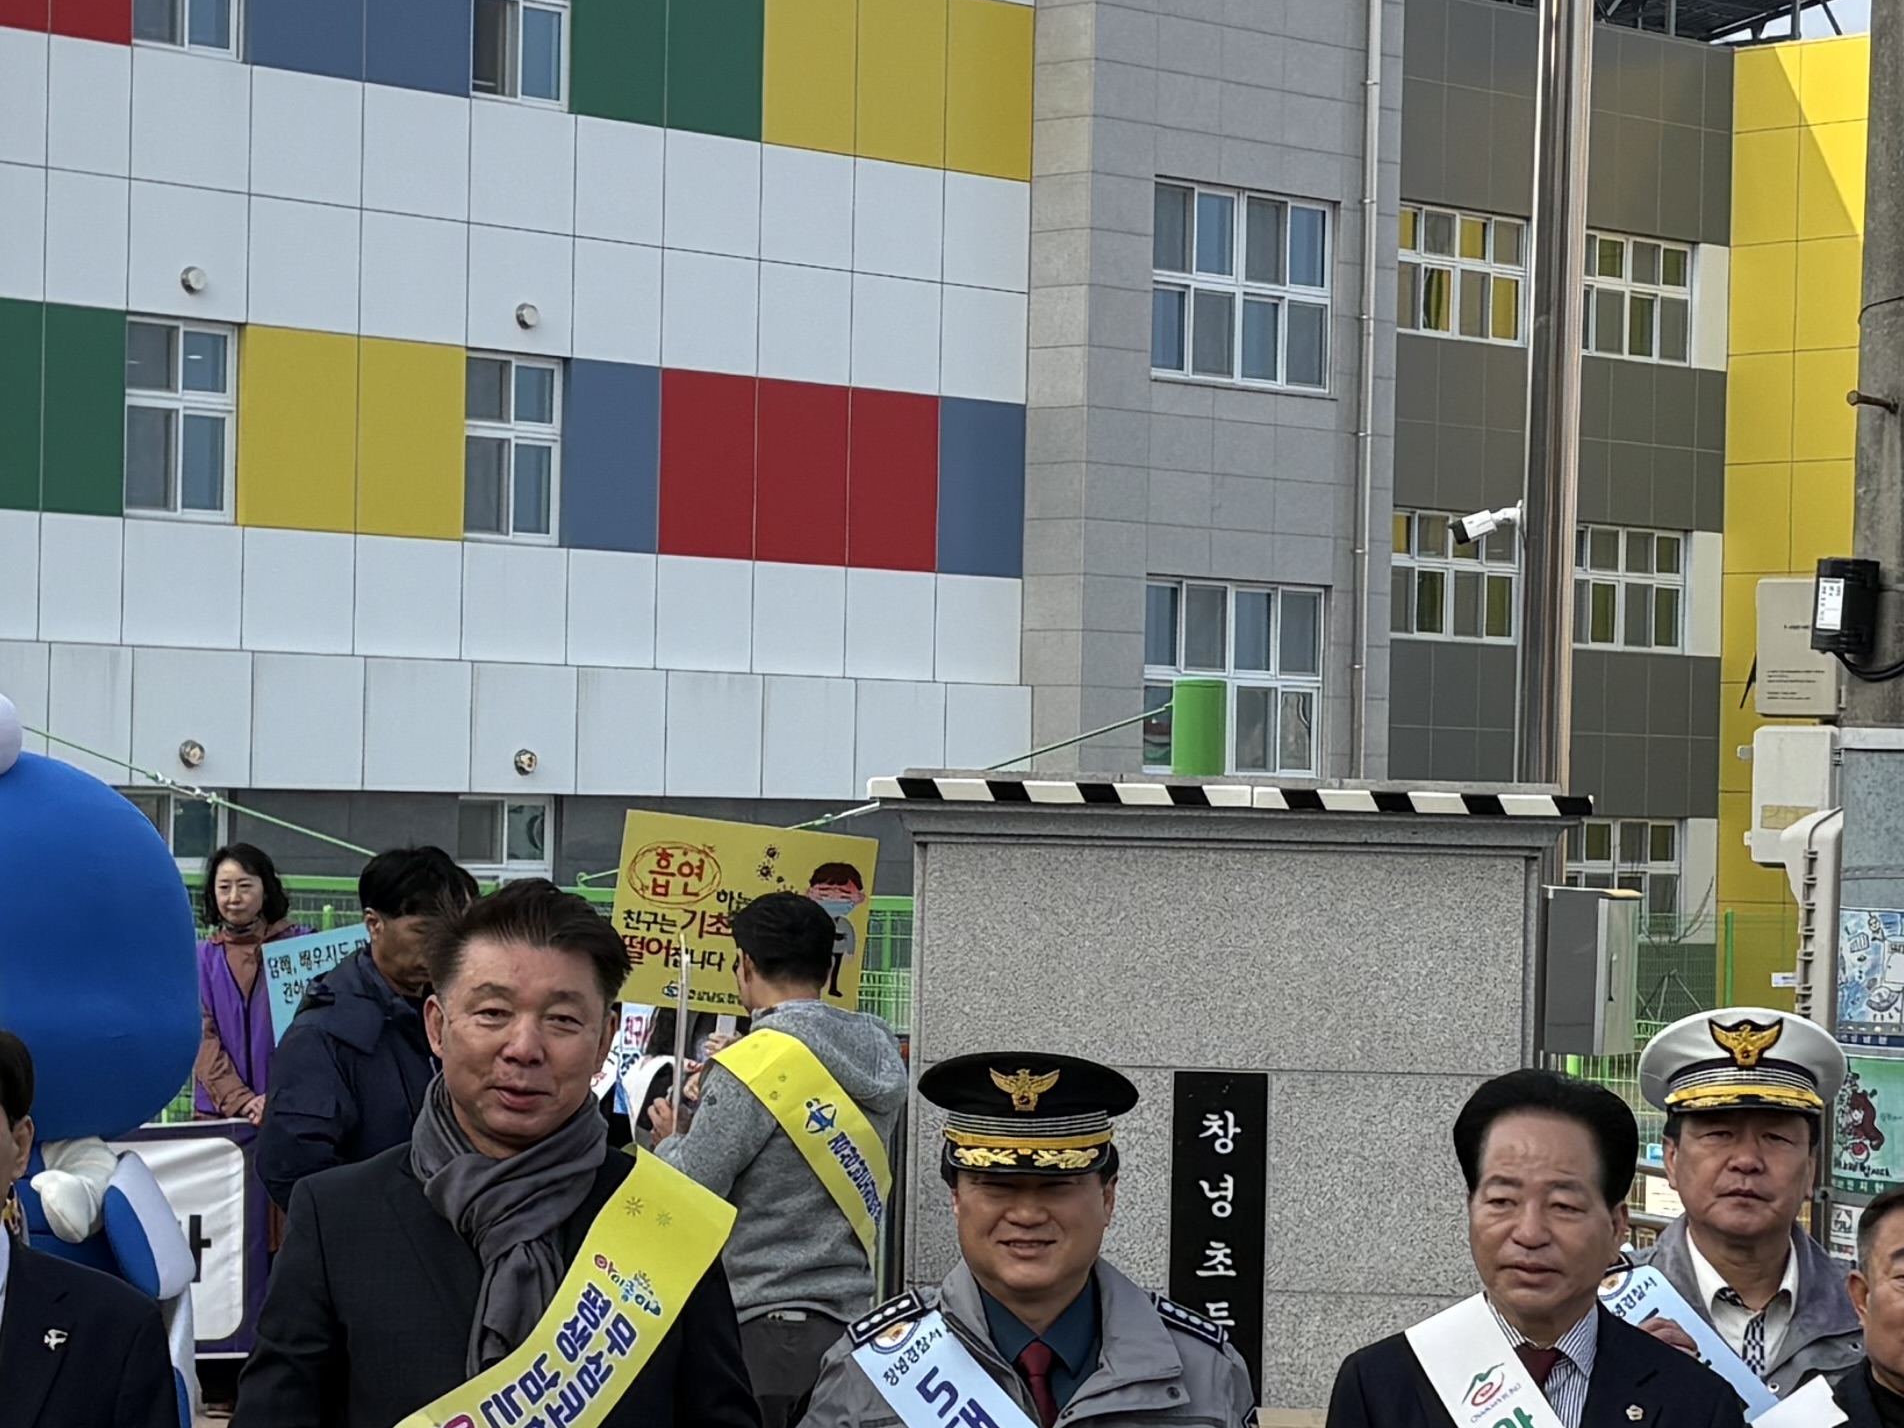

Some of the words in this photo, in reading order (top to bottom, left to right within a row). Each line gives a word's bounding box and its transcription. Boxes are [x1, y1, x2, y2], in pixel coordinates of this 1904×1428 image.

[648, 847, 706, 898] 흡연
[623, 908, 677, 934] 친구는
[556, 1282, 613, 1364] 평생
